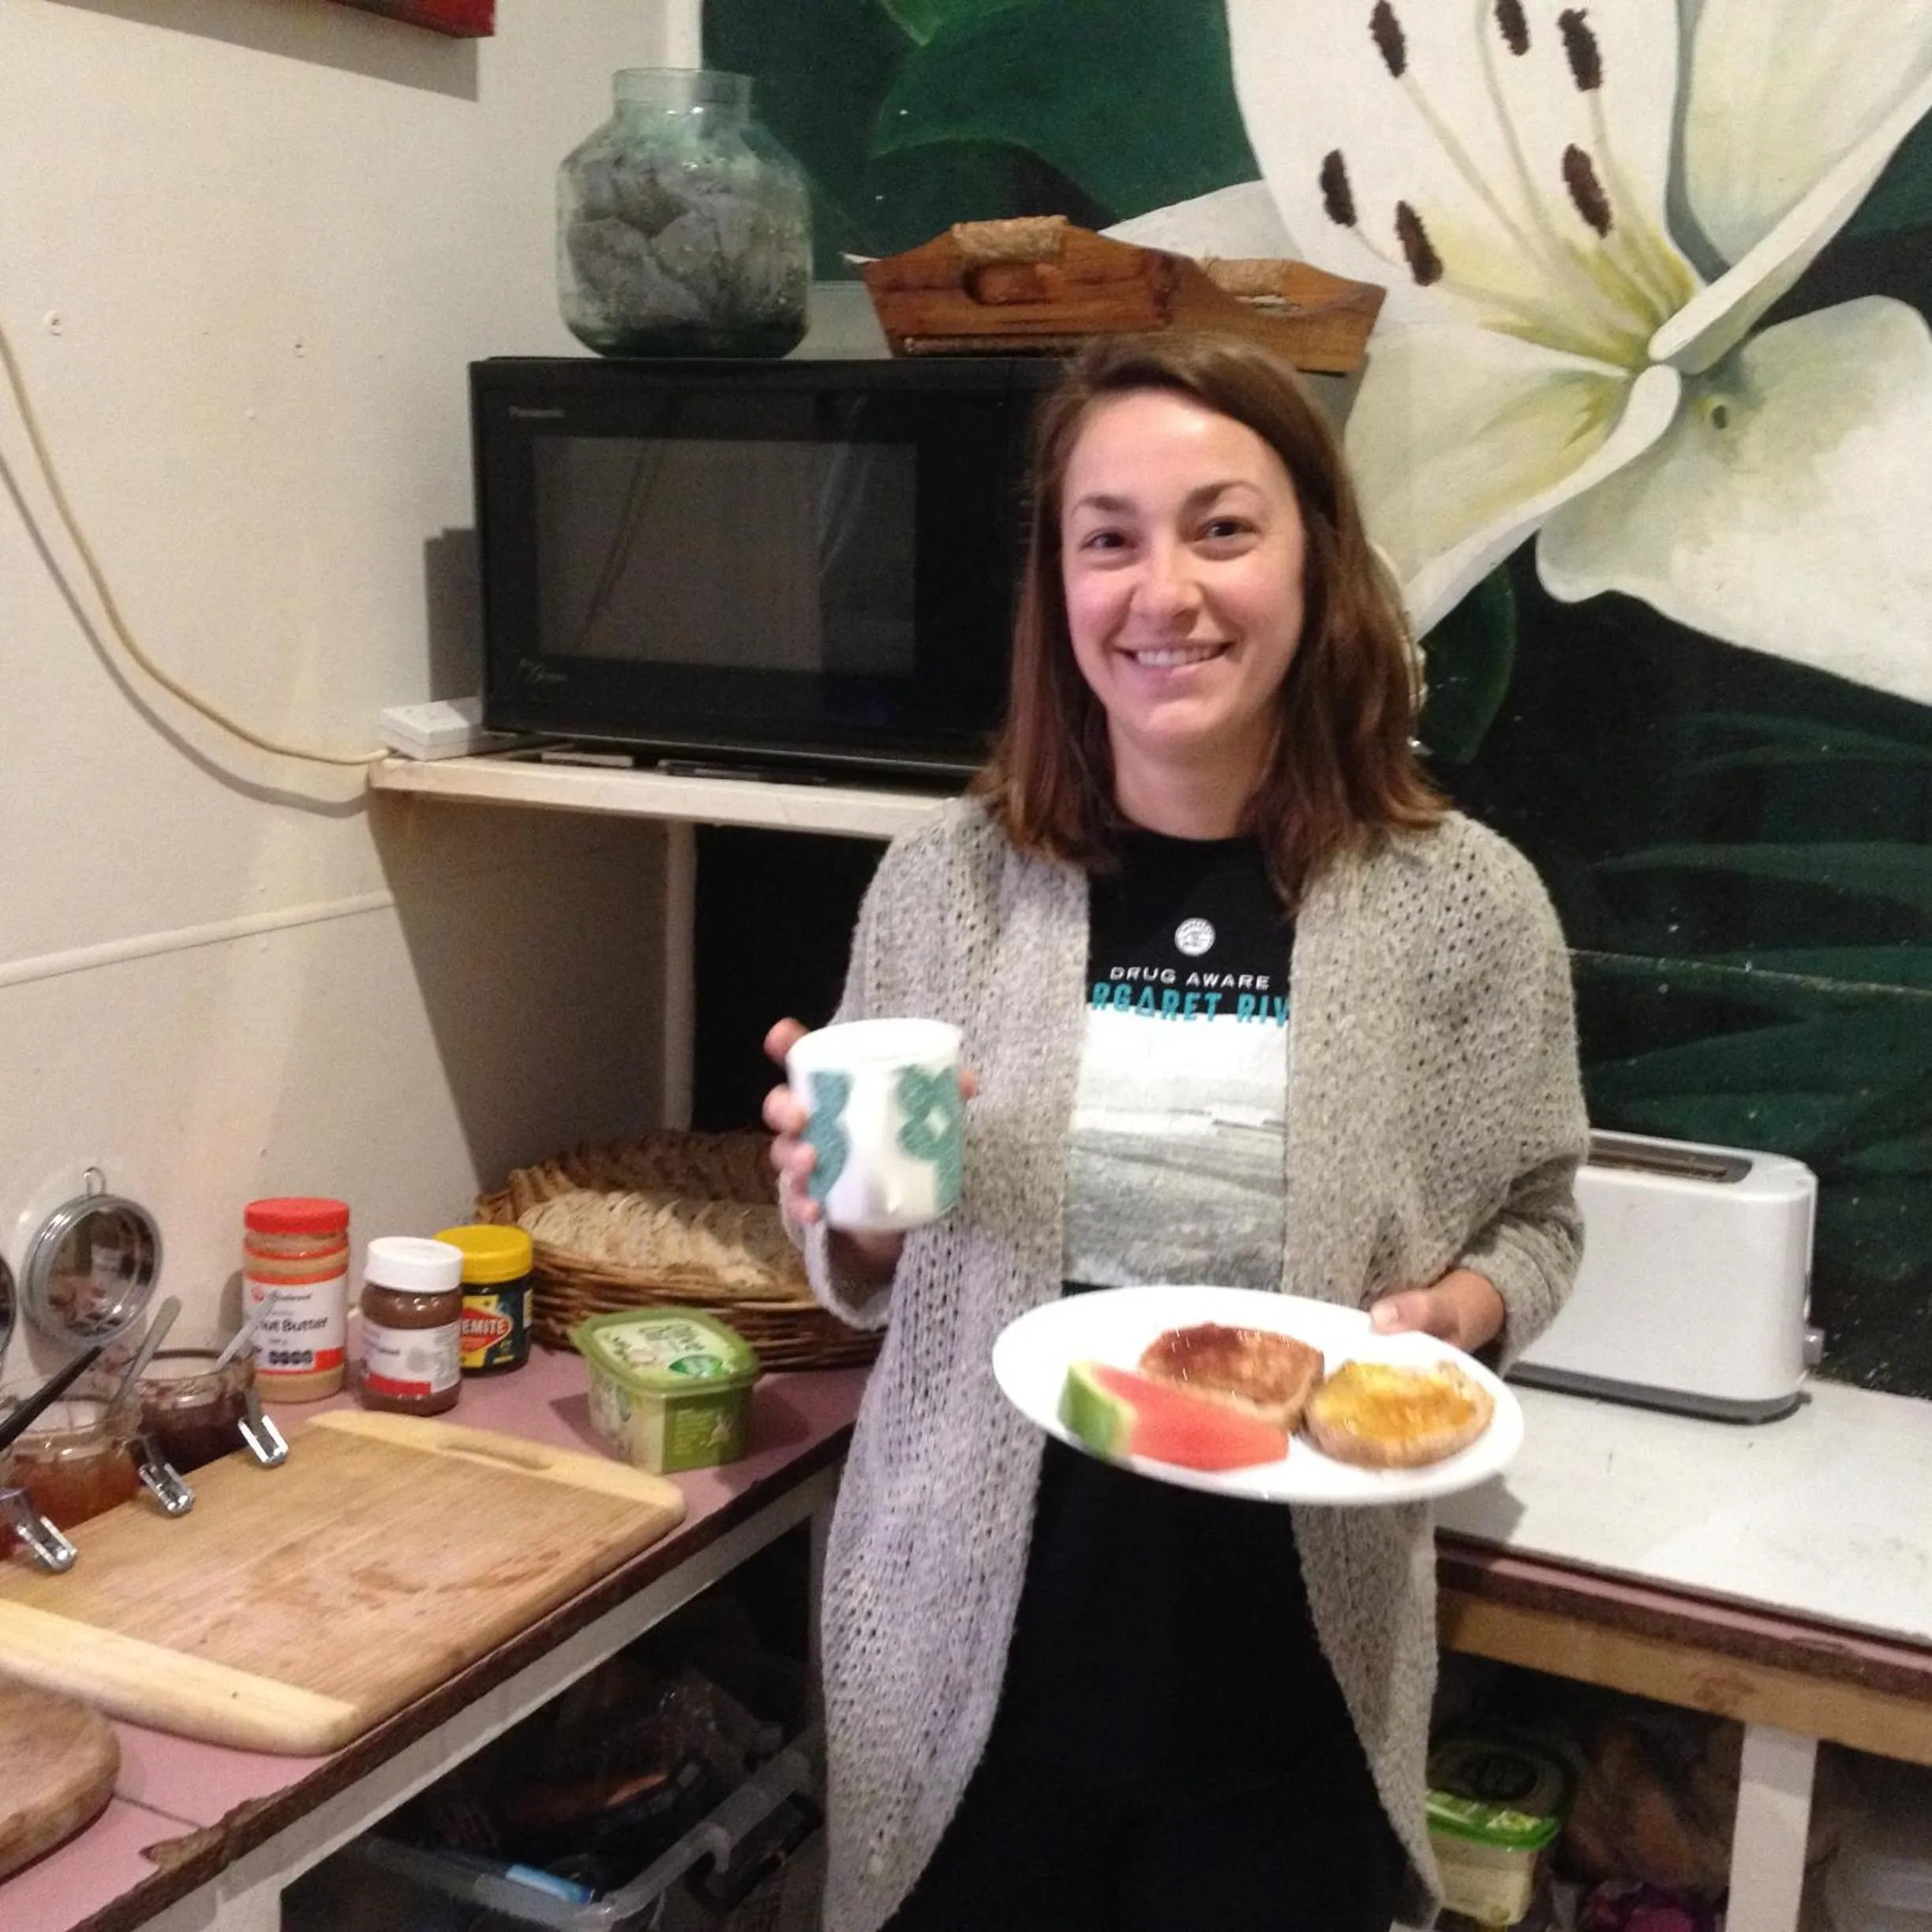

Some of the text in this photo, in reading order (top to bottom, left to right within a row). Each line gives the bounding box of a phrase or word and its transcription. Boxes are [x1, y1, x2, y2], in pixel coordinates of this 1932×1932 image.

[1110, 966, 1271, 990] DRUG AWARE
[1091, 982, 1222, 1021] RGARET
